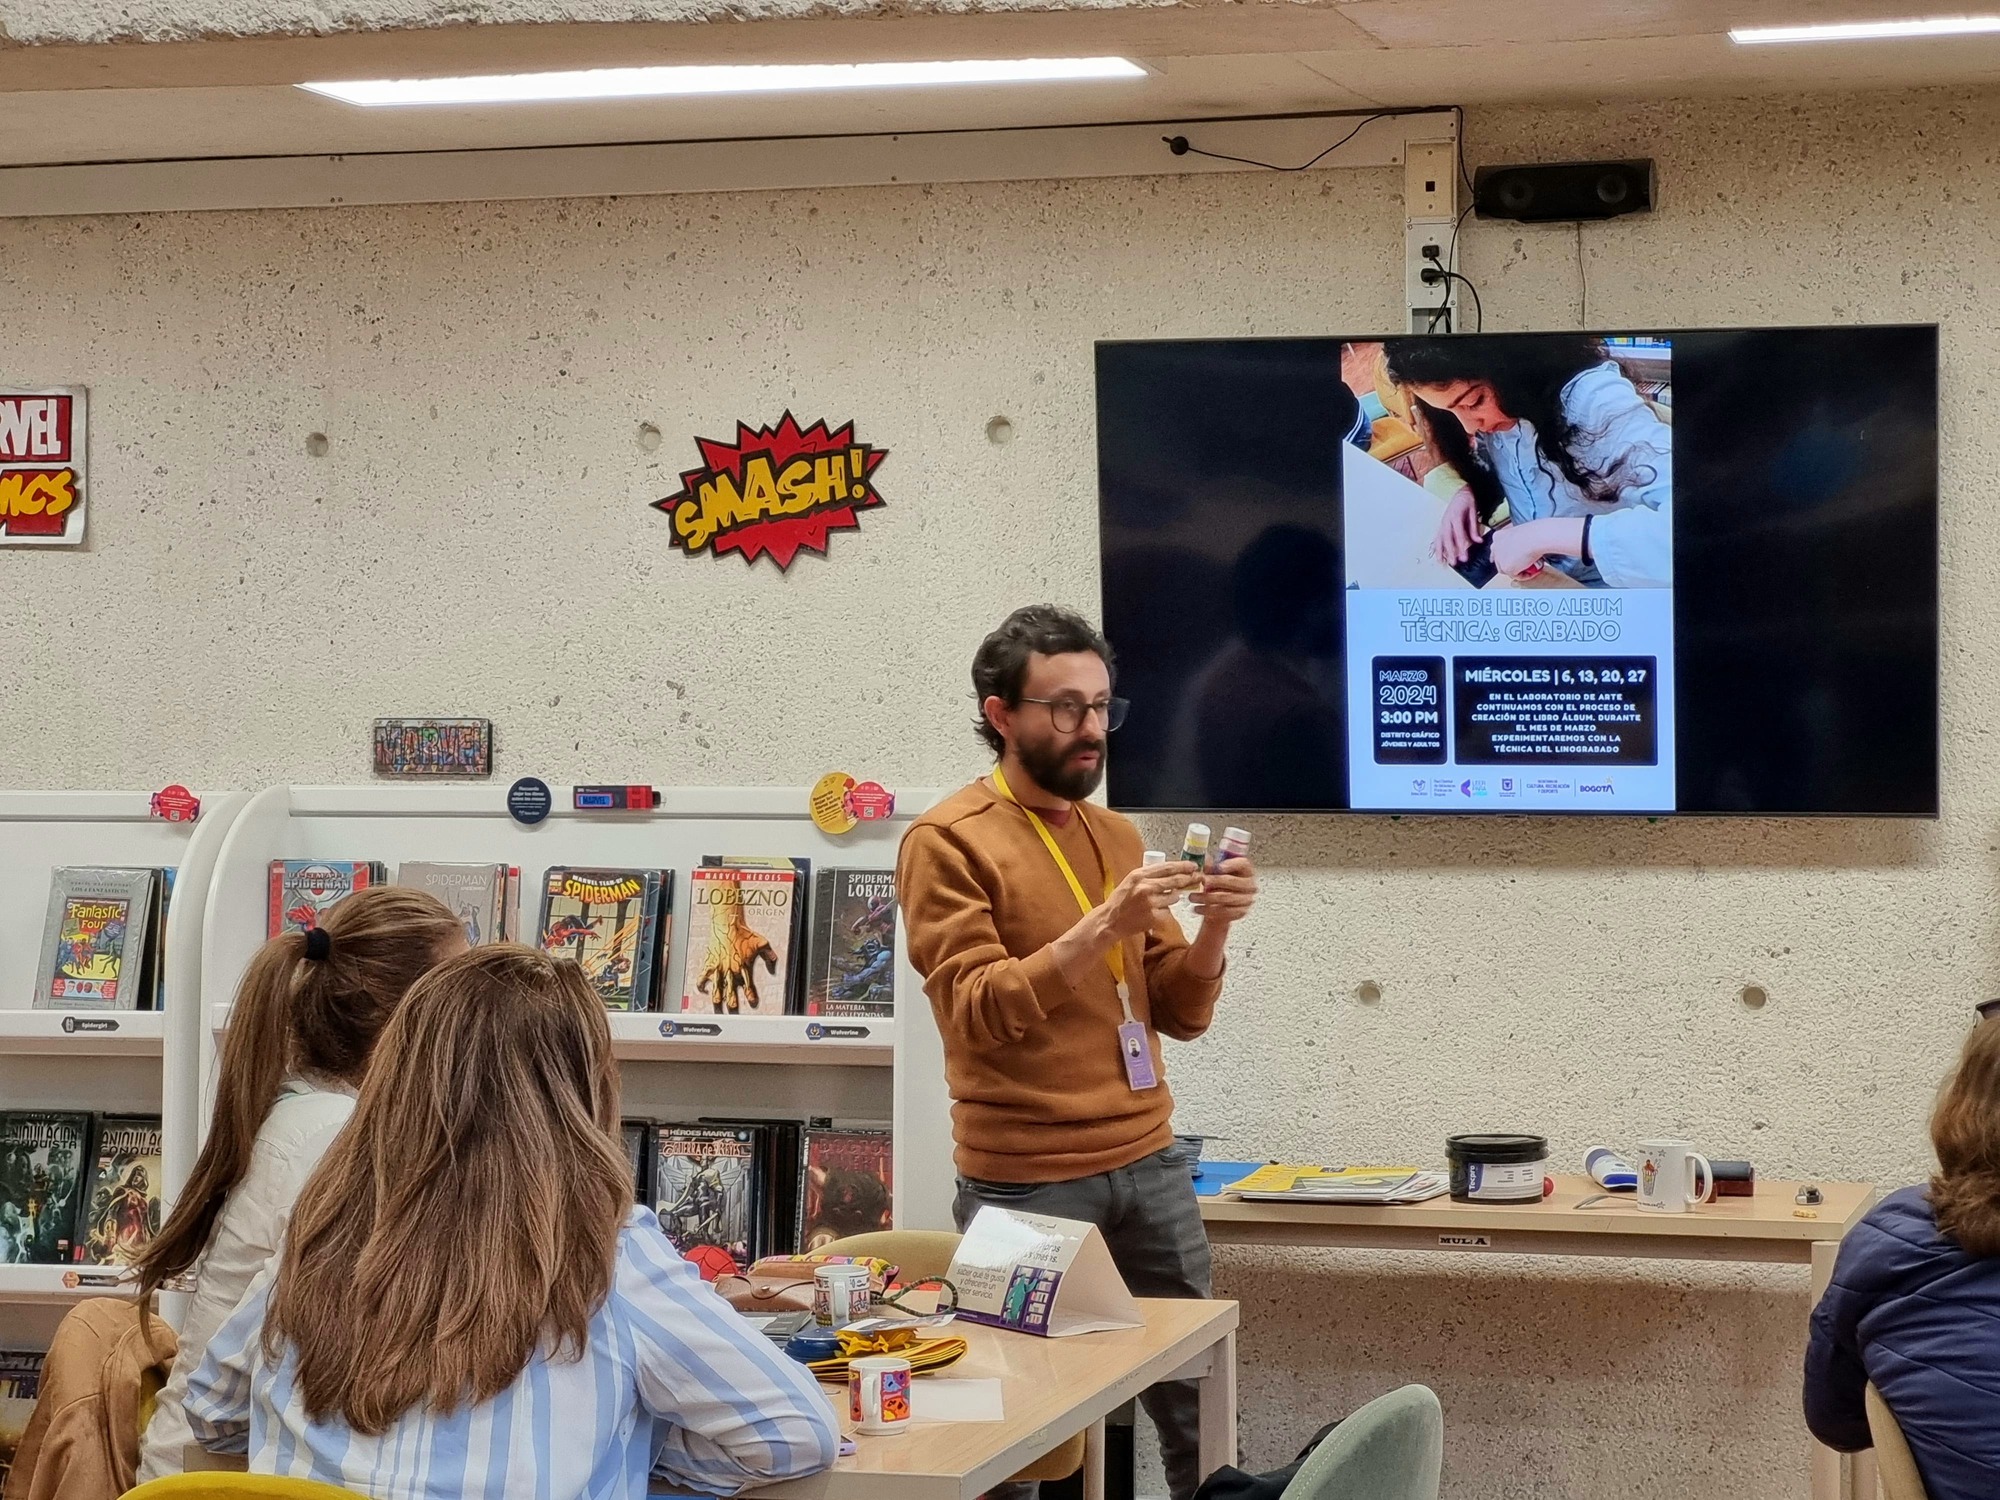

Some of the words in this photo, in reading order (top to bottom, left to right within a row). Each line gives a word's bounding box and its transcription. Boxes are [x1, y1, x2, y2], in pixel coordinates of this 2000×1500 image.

[674, 449, 866, 549] SMASH!
[1398, 598, 1464, 616] TALLER
[1468, 598, 1492, 616] DE
[1497, 598, 1553, 616] LIBRO
[1556, 598, 1622, 616] ALBUM
[1401, 617, 1500, 642] TÉCNICA:
[1505, 620, 1621, 642] GRABADO
[1379, 670, 1428, 682] MARZO
[1465, 667, 1550, 682] MIÉRCOLES
[1561, 669, 1575, 685] 6,
[1578, 669, 1598, 685] 13,
[1601, 669, 1625, 685] 20,
[1628, 669, 1647, 683] 27
[1380, 685, 1437, 705] 2024
[1380, 711, 1412, 724] 3:00
[1415, 711, 1439, 724] PM
[1471, 713, 1517, 721] CREACIÓN
[1411, 731, 1440, 739] GRÁFICO
[374, 726, 487, 766] MARVEL
[1494, 744, 1533, 753] TÉCNICA
[425, 873, 487, 886] SPIDERMAN
[705, 872, 741, 880] MARVEL
[284, 879, 350, 890] SPIDERMAN
[562, 879, 641, 905] SPIDERMAN
[696, 887, 788, 907] LOBEZNO
[71, 903, 121, 919] Fantastic
[748, 908, 786, 917] ORIGEN
[683, 1026, 711, 1034] Wolverine
[1468, 1165, 1477, 1190] Tecpro
